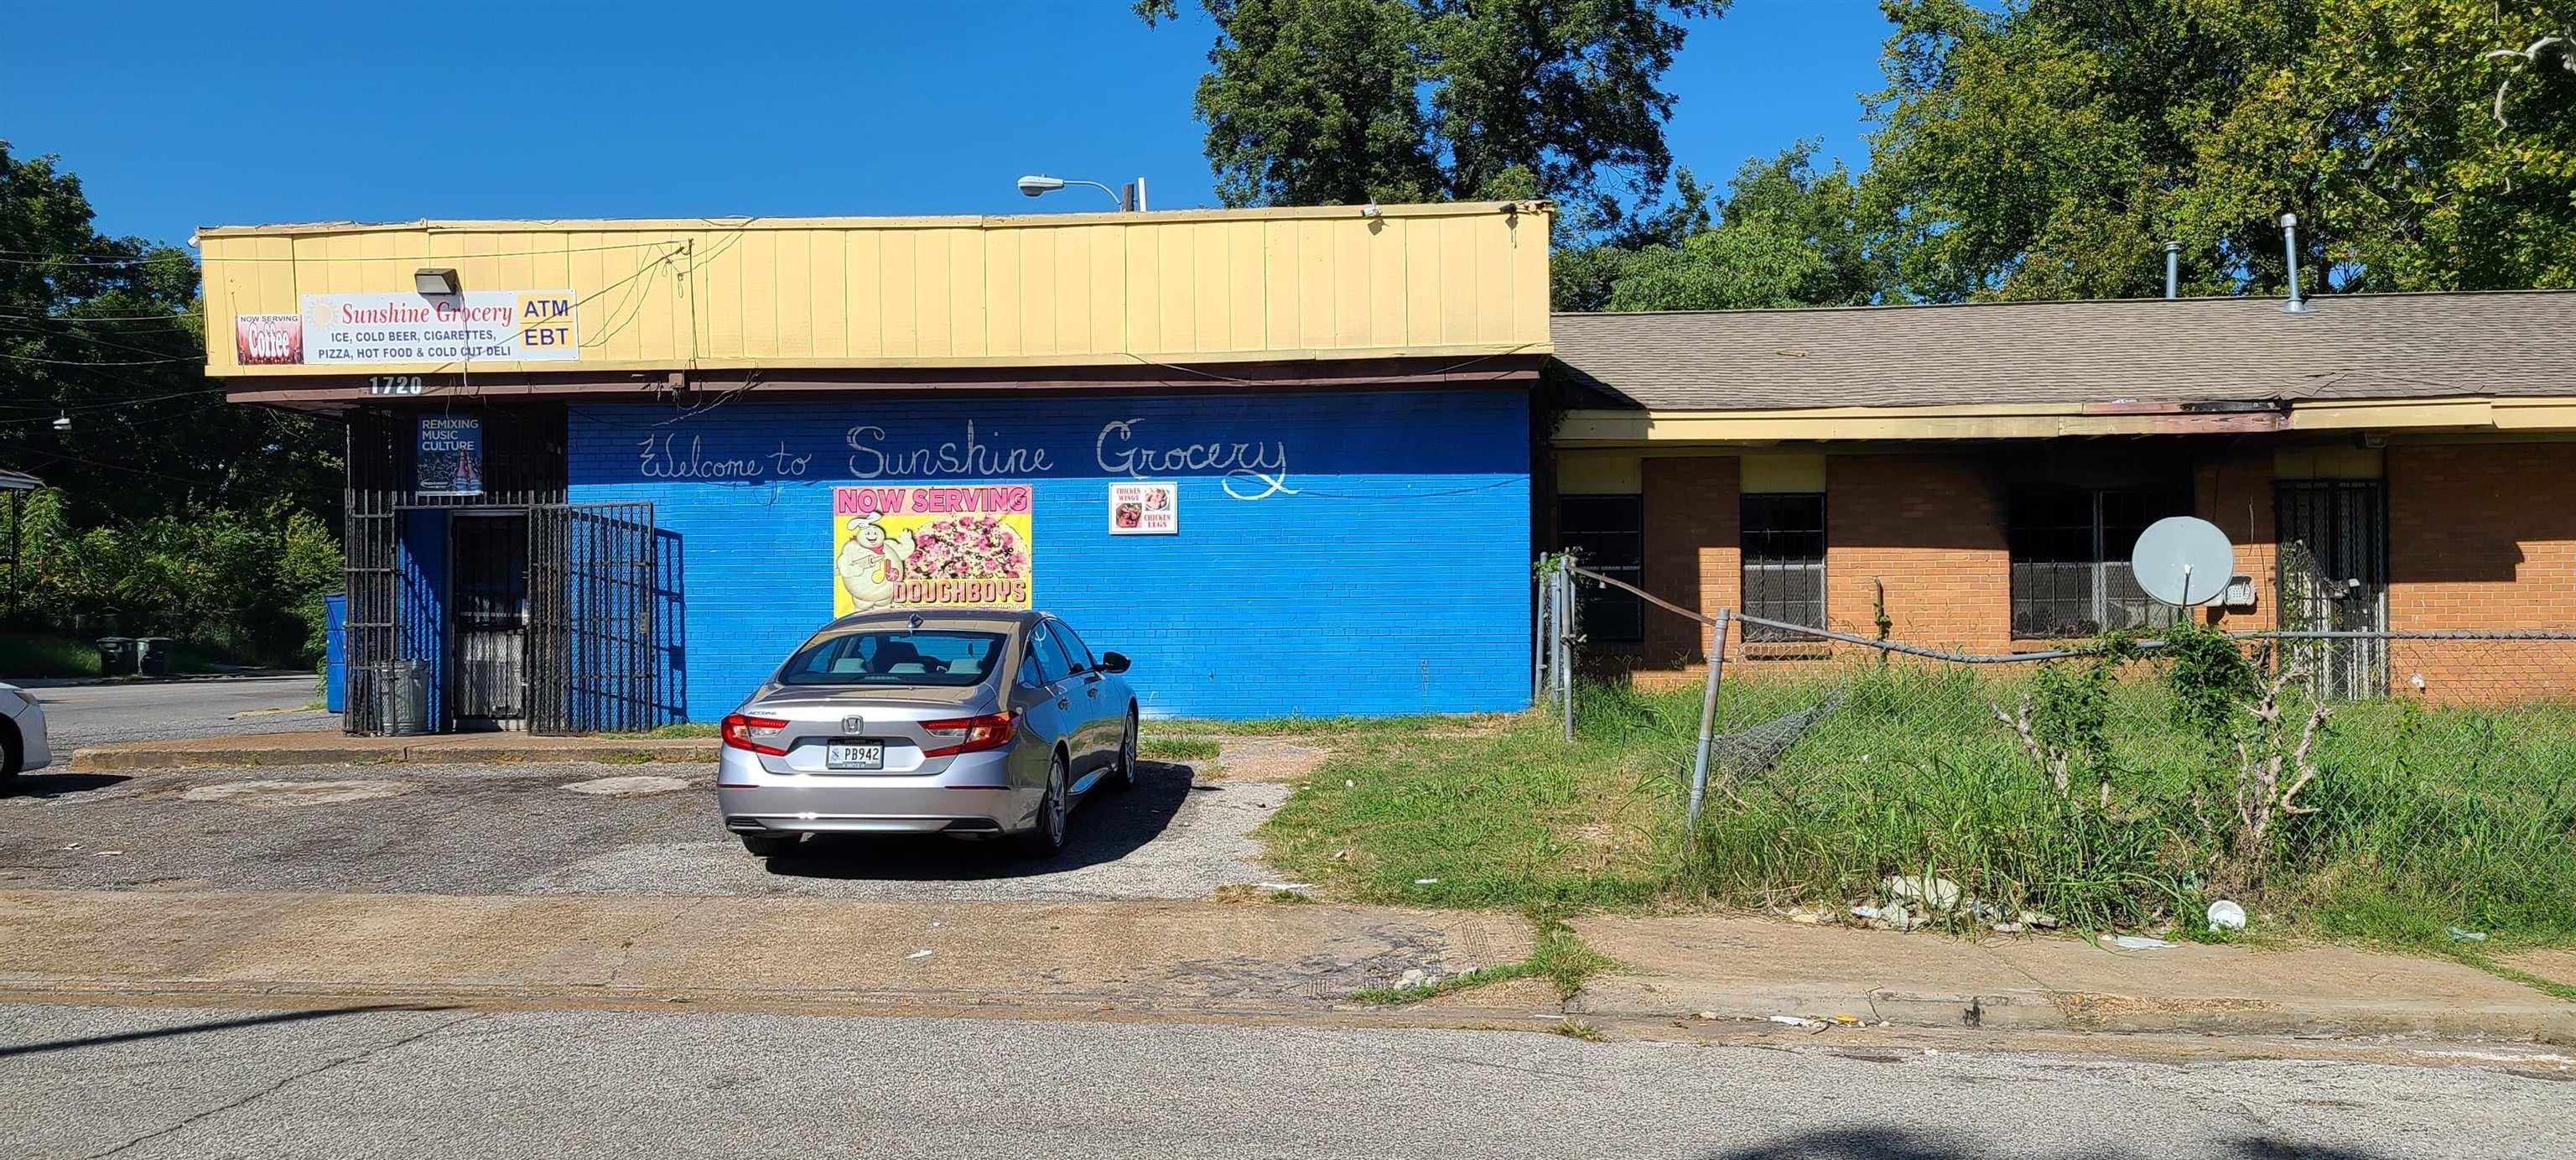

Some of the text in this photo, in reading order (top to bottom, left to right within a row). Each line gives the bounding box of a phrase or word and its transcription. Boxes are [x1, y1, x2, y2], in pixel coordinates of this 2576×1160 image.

[342, 301, 513, 327] Sunshine Grocery
[524, 299, 569, 317] ATM
[248, 321, 289, 358] Coffee
[331, 330, 496, 344] ICE, COLD BEER, CIGARETTES,
[525, 328, 569, 346] EBT
[319, 346, 511, 361] PIZZA, HOT FOOD & COLD CUT DELI
[370, 377, 422, 394] 1720
[422, 419, 479, 429] REMIXING
[422, 430, 459, 440] MUSIC
[422, 441, 475, 451] CULTURE
[637, 418, 1301, 500] Welcome to Sunshine Grocery
[839, 487, 1027, 513] NOW SERVING
[893, 580, 1027, 603] DOUGHBOYS
[844, 747, 879, 760] PB942
